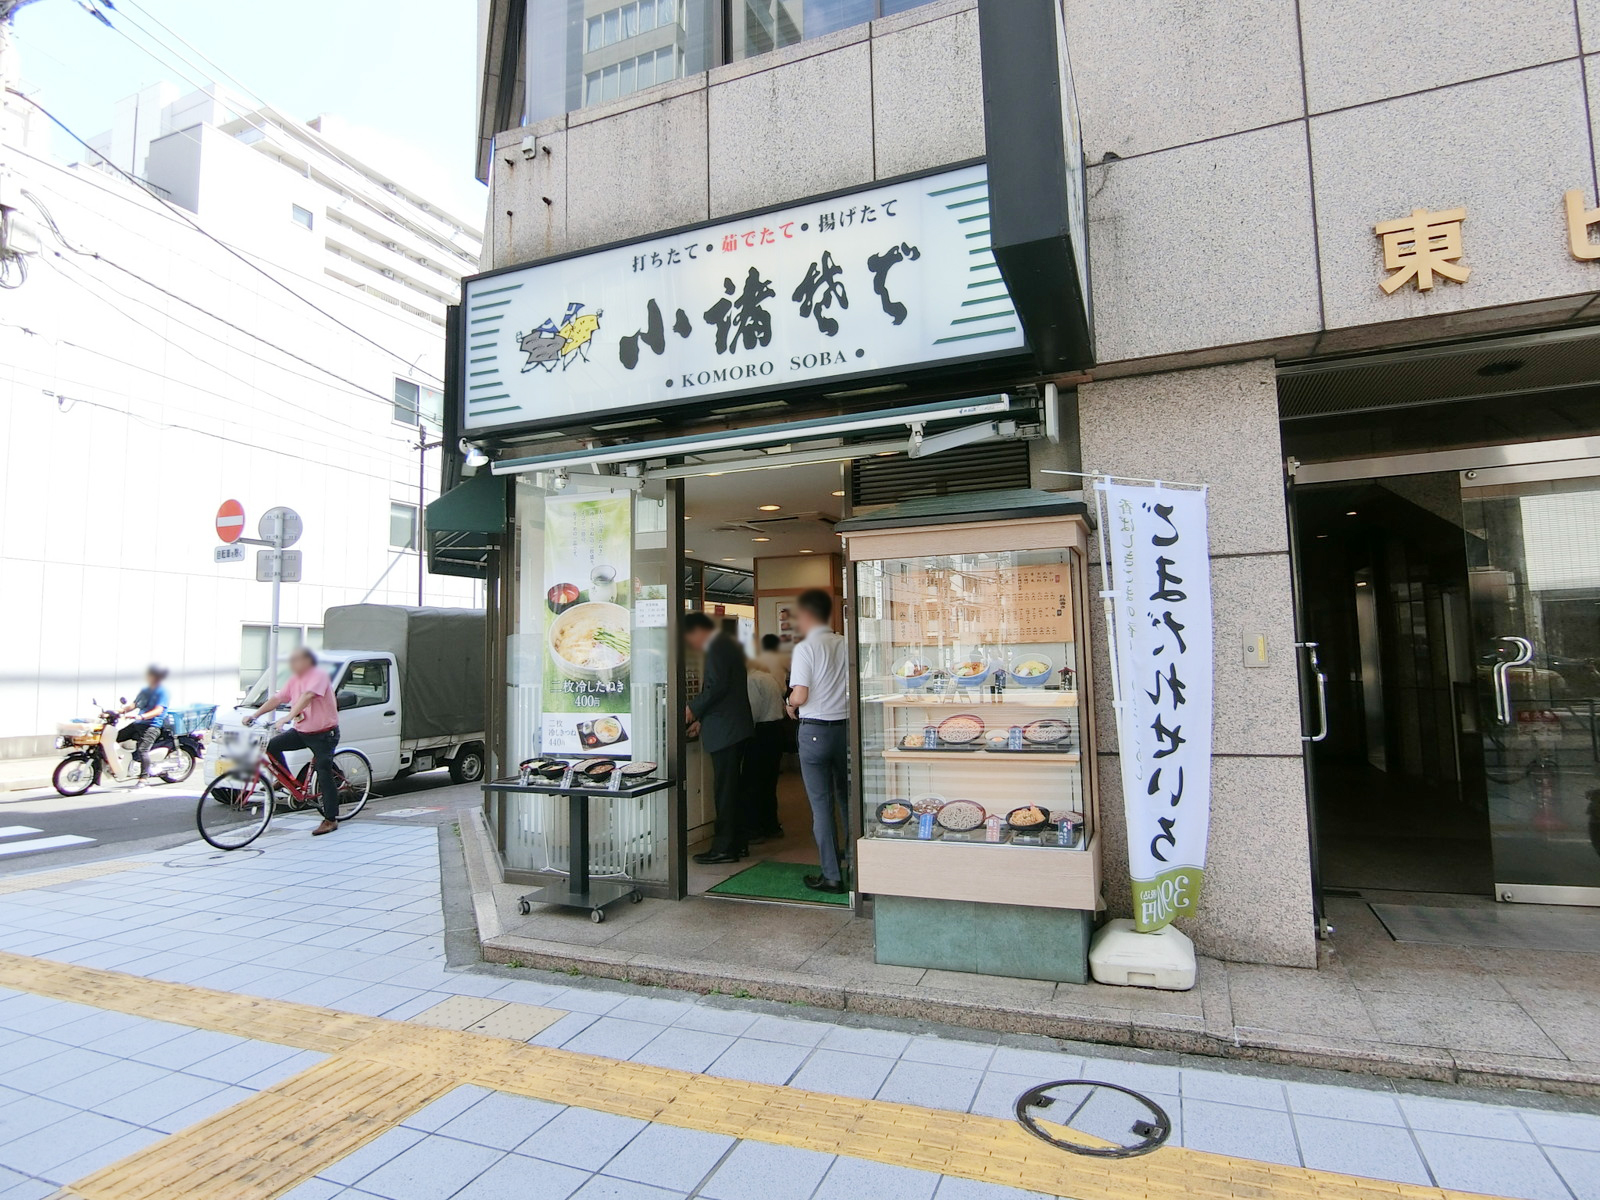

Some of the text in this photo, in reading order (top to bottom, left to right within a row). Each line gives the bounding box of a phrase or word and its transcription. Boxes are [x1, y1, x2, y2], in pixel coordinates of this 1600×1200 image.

[632, 199, 898, 272] 打ちたて 茹でたて 揚げたて
[681, 350, 847, 388] KOMORO SOBA
[550, 680, 624, 694] 二枚冷したぬき
